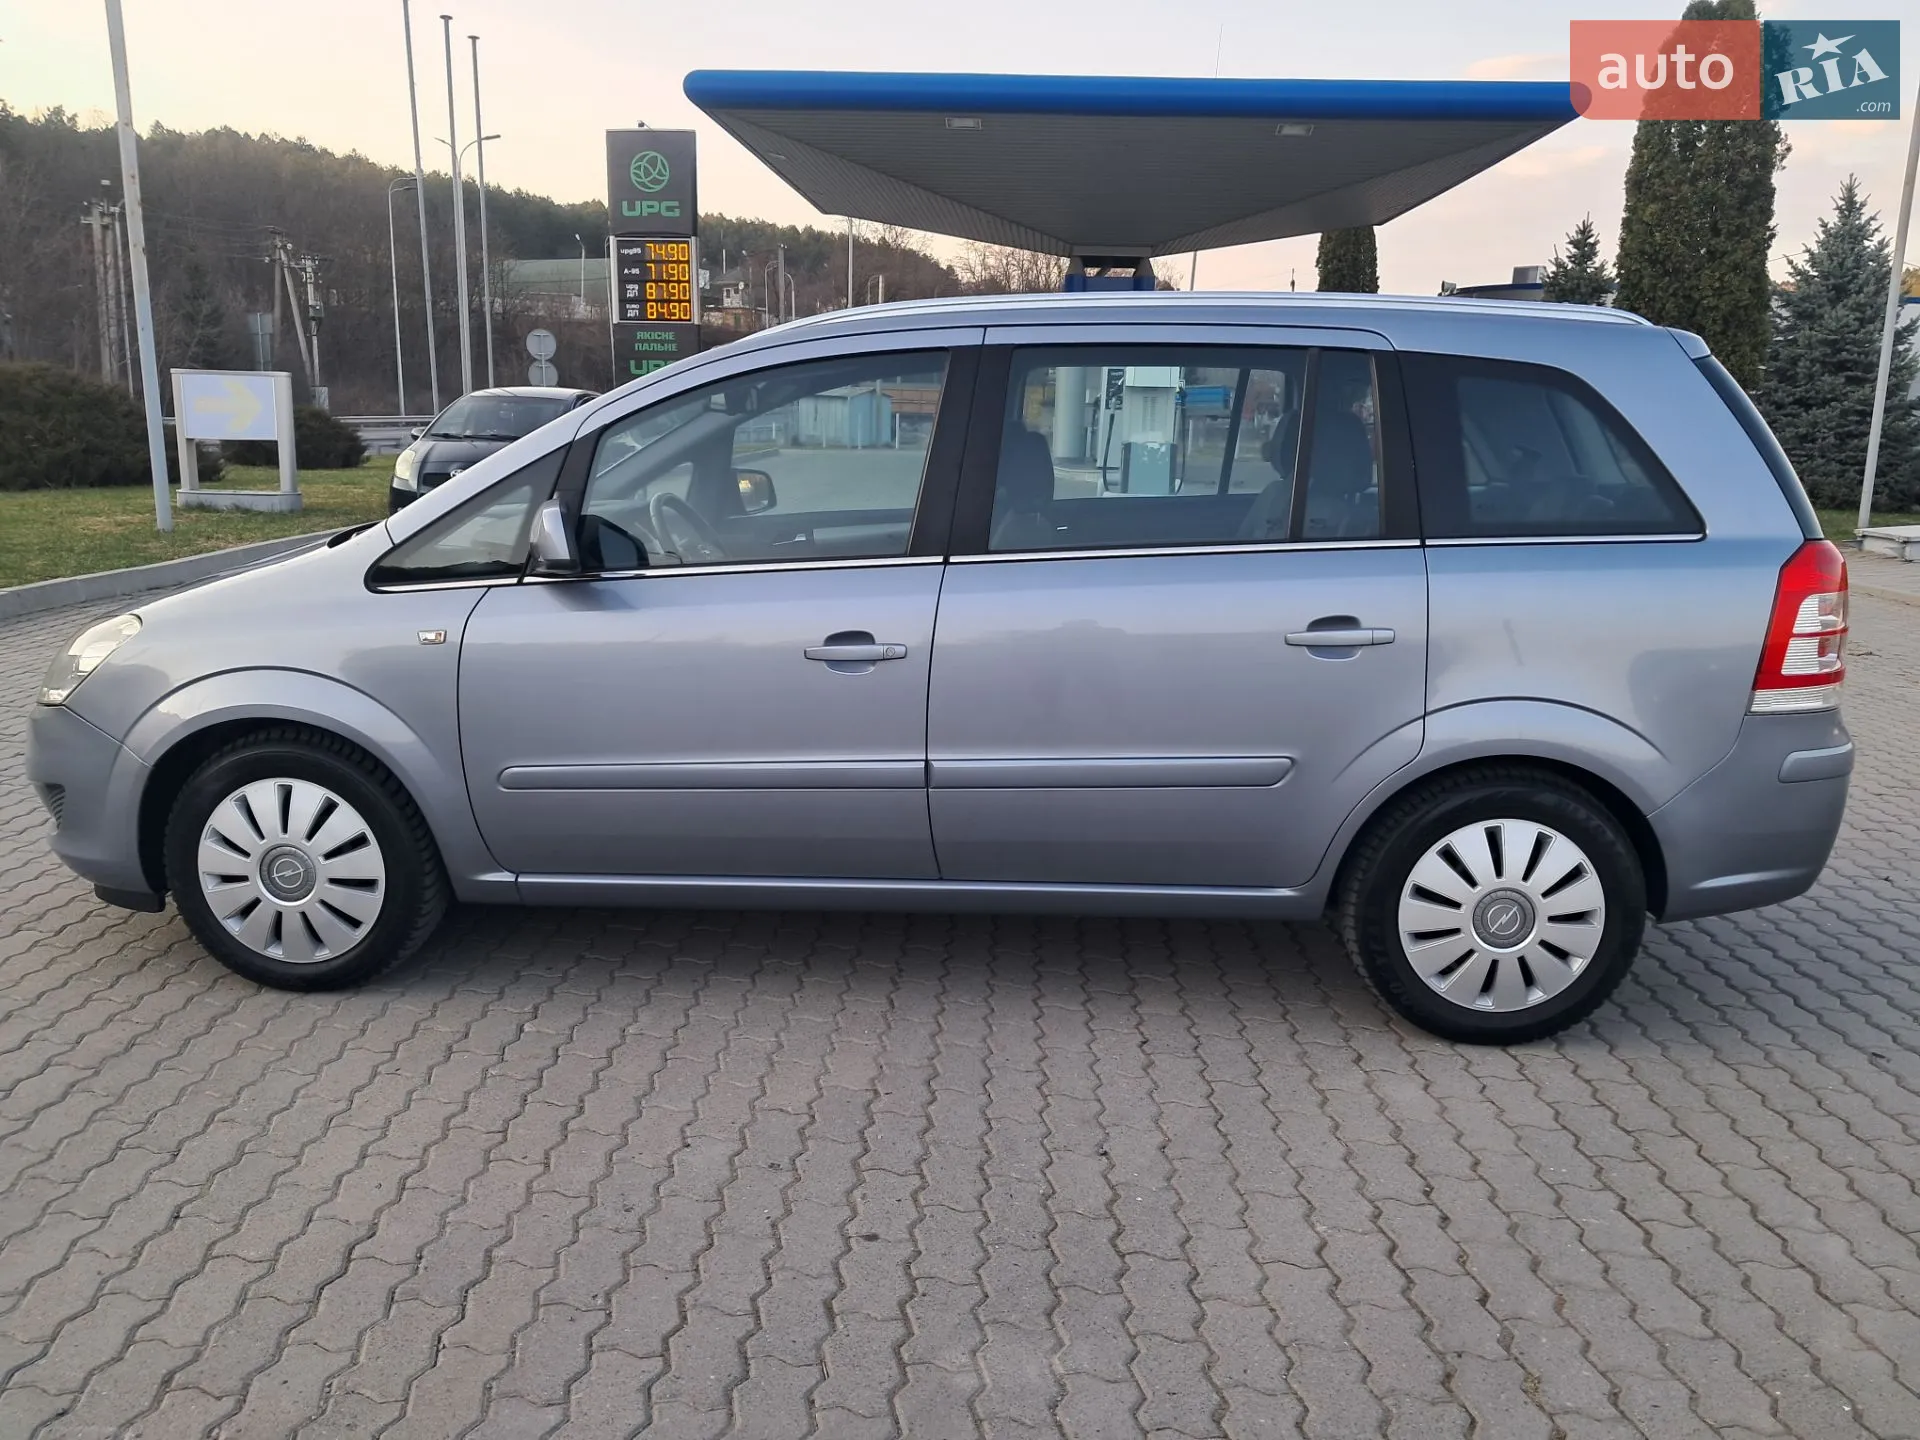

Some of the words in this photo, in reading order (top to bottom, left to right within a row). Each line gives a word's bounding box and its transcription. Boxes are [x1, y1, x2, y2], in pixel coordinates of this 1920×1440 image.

[622, 201, 680, 216] UPG
[645, 243, 689, 261] 74.90
[646, 263, 689, 281] 71.90
[646, 282, 690, 300] 87.90
[647, 302, 690, 320] 84.90
[636, 331, 676, 340] ЯКІСНЕ
[634, 342, 679, 352] ПАЛЬНЕ
[629, 359, 677, 375] UP
